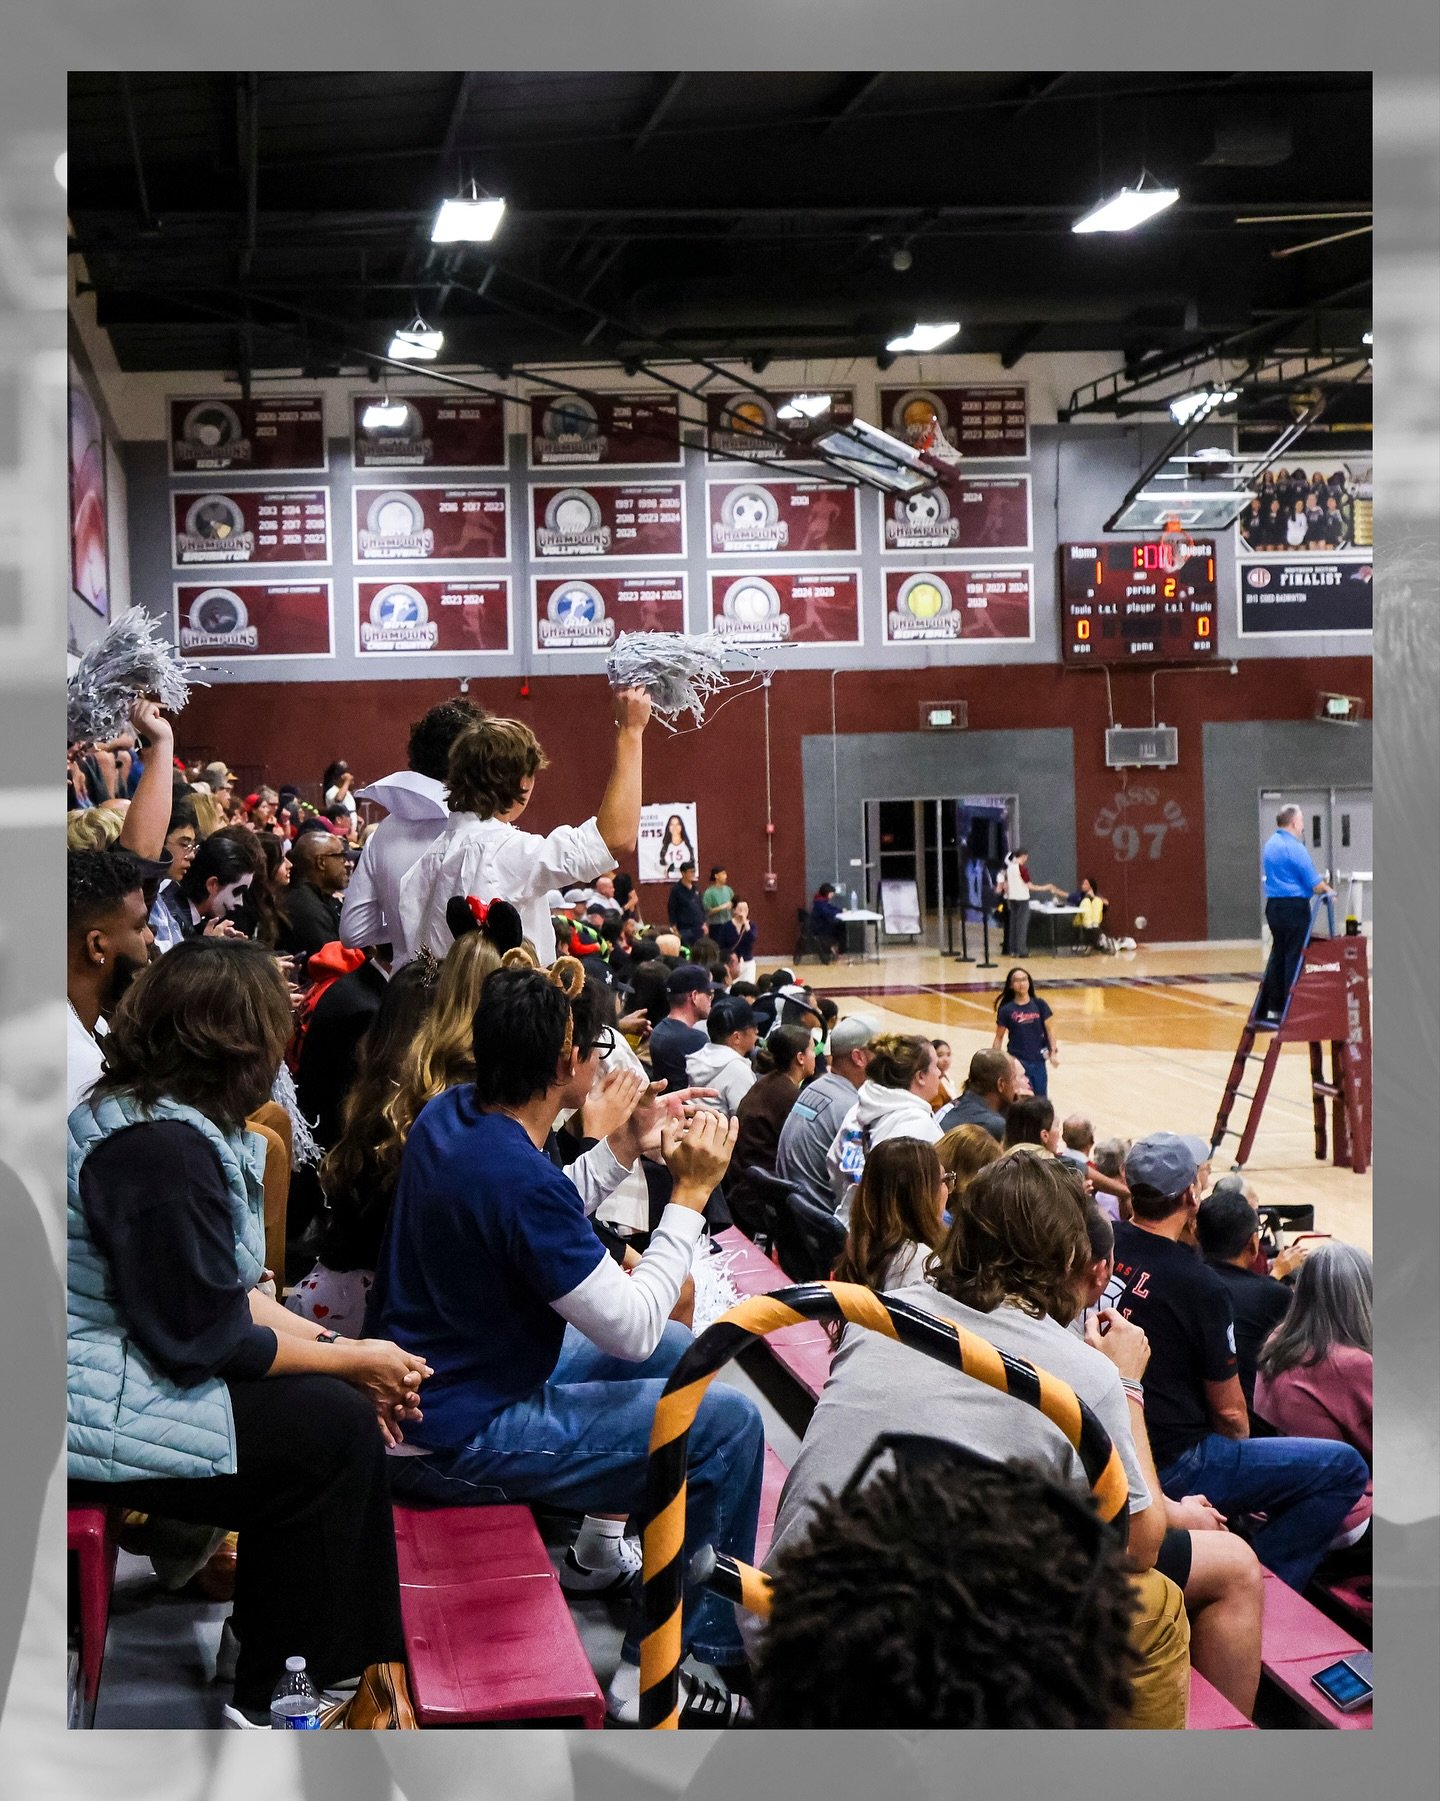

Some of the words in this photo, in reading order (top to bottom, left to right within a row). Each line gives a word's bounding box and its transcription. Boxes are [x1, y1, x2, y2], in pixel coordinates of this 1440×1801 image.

[715, 526, 786, 541] CHAMPIONS
[888, 525, 959, 538] CHAMPIONS
[361, 534, 432, 549] CHAMPIONS
[539, 532, 610, 546] CHAMPIONS
[1071, 546, 1097, 559] Home
[1280, 573, 1342, 586] FINALIST
[1126, 584, 1156, 597] period
[1164, 578, 1176, 598] 2
[1126, 602, 1155, 614] player
[718, 621, 788, 635] CHAMPIONS
[892, 617, 960, 630] CHAMPIONS
[1077, 620, 1090, 639] 0
[1198, 616, 1210, 637] 0
[364, 628, 435, 642] CHAMPIONS
[542, 625, 612, 638] CHAMPIONS
[183, 633, 256, 648] CHAMPIONS
[1073, 644, 1091, 653] won
[1130, 641, 1154, 654] game
[1193, 641, 1211, 650] won
[1094, 785, 1160, 837] CLASS
[641, 829, 663, 838] #15
[1112, 824, 1168, 862] 97
[669, 849, 684, 861] 15
